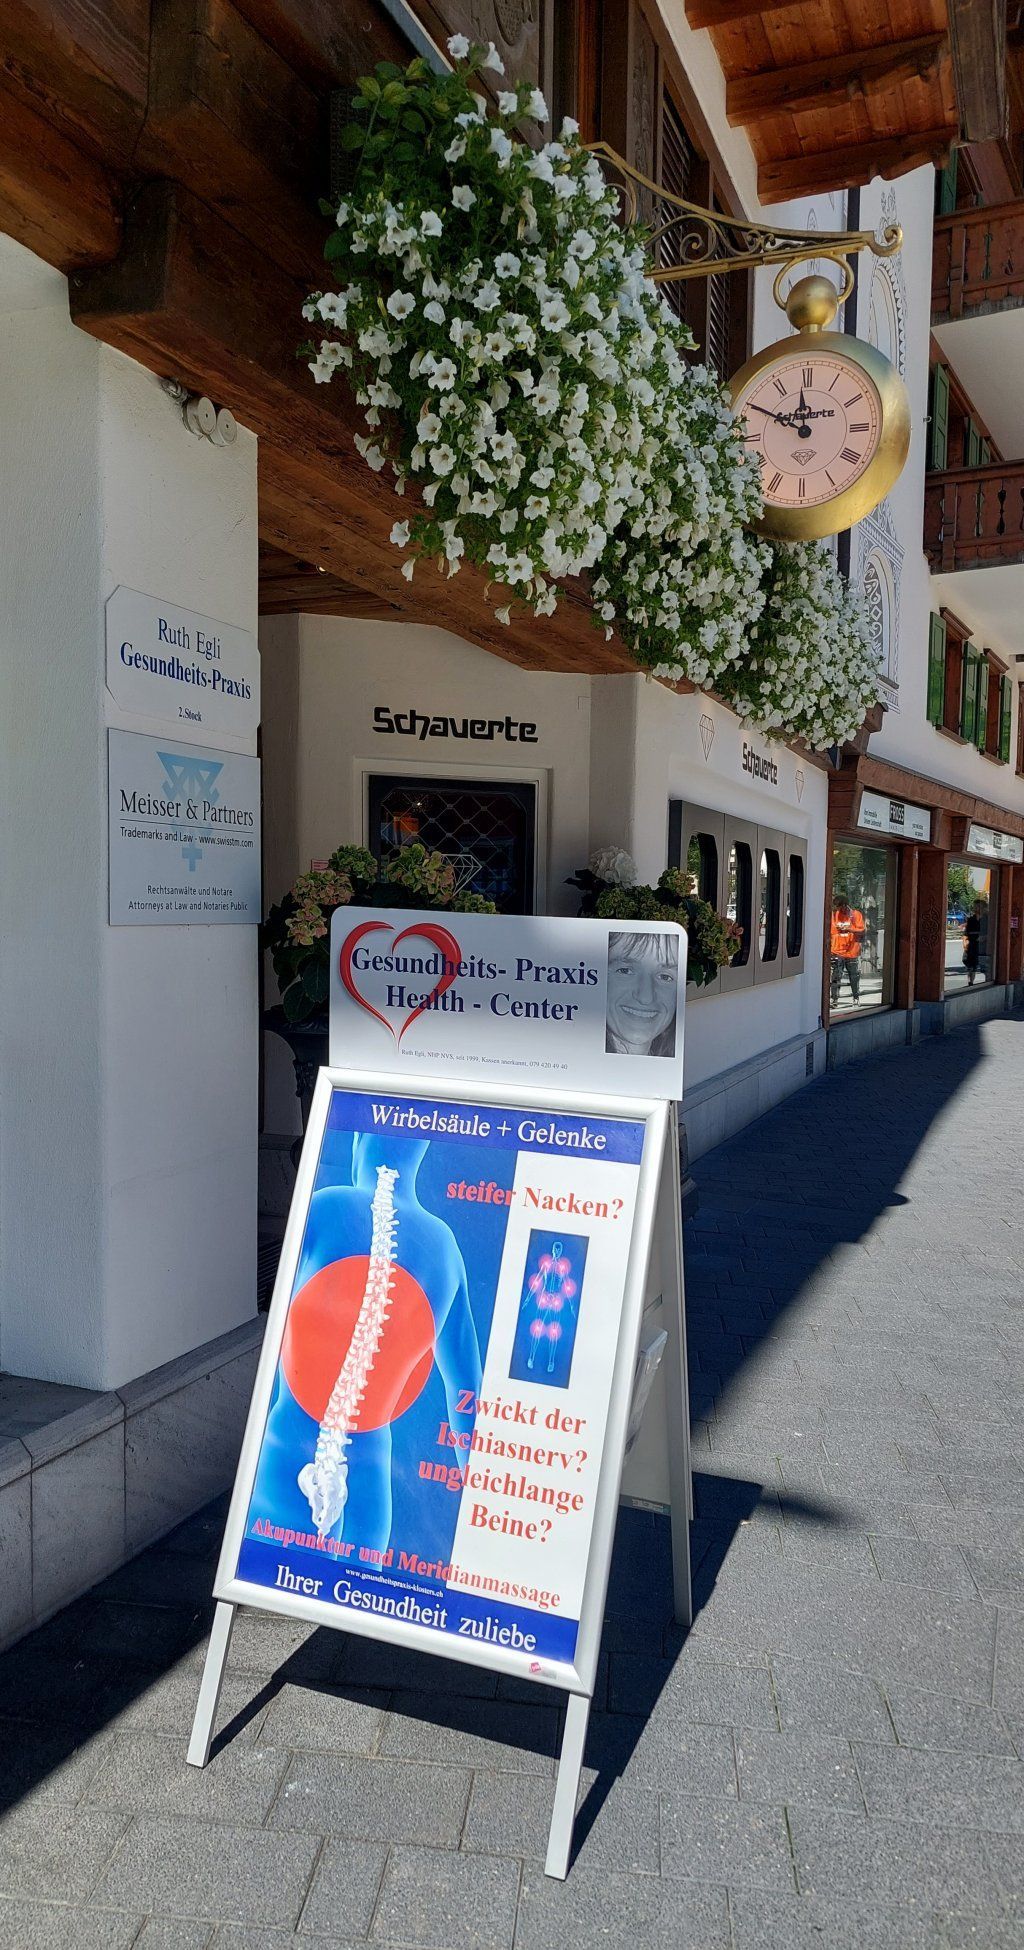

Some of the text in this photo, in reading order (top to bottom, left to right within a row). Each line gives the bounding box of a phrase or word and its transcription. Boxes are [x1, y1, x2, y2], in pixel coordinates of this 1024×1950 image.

[158, 617, 221, 661] Ruth Egli
[120, 641, 251, 700] Gesundheits-Praxis
[178, 706, 202, 722] 2.Stock
[120, 789, 254, 827] Meisser & Partners
[120, 826, 163, 841] Trademarks
[164, 831, 178, 842] and
[179, 831, 194, 843] Law
[199, 835, 254, 848] www.swisstm.com
[128, 900, 248, 912] Attorneys at Law and Notaries Public
[147, 884, 233, 897] Rechtsanwälte und Notare
[351, 947, 599, 987] Gesundheits- Praxis
[385, 984, 465, 1013] Health
[489, 991, 579, 1022] Center
[371, 1103, 607, 1151] Wirbelsäule + Gelenke
[446, 1180, 624, 1220] steifer Nacken?
[455, 1388, 586, 1435] Zwickt der
[436, 1421, 588, 1474] Ischiasnerv?
[418, 1459, 584, 1516] ungleichlange
[468, 1503, 553, 1543] Beine?
[251, 1518, 561, 1609] Akupunktur und Meridianmassage
[345, 1568, 444, 1599] www.gesundheitspraxis-klosters.ch
[274, 1564, 537, 1652] Ihrer Gesundheit zuliebe
